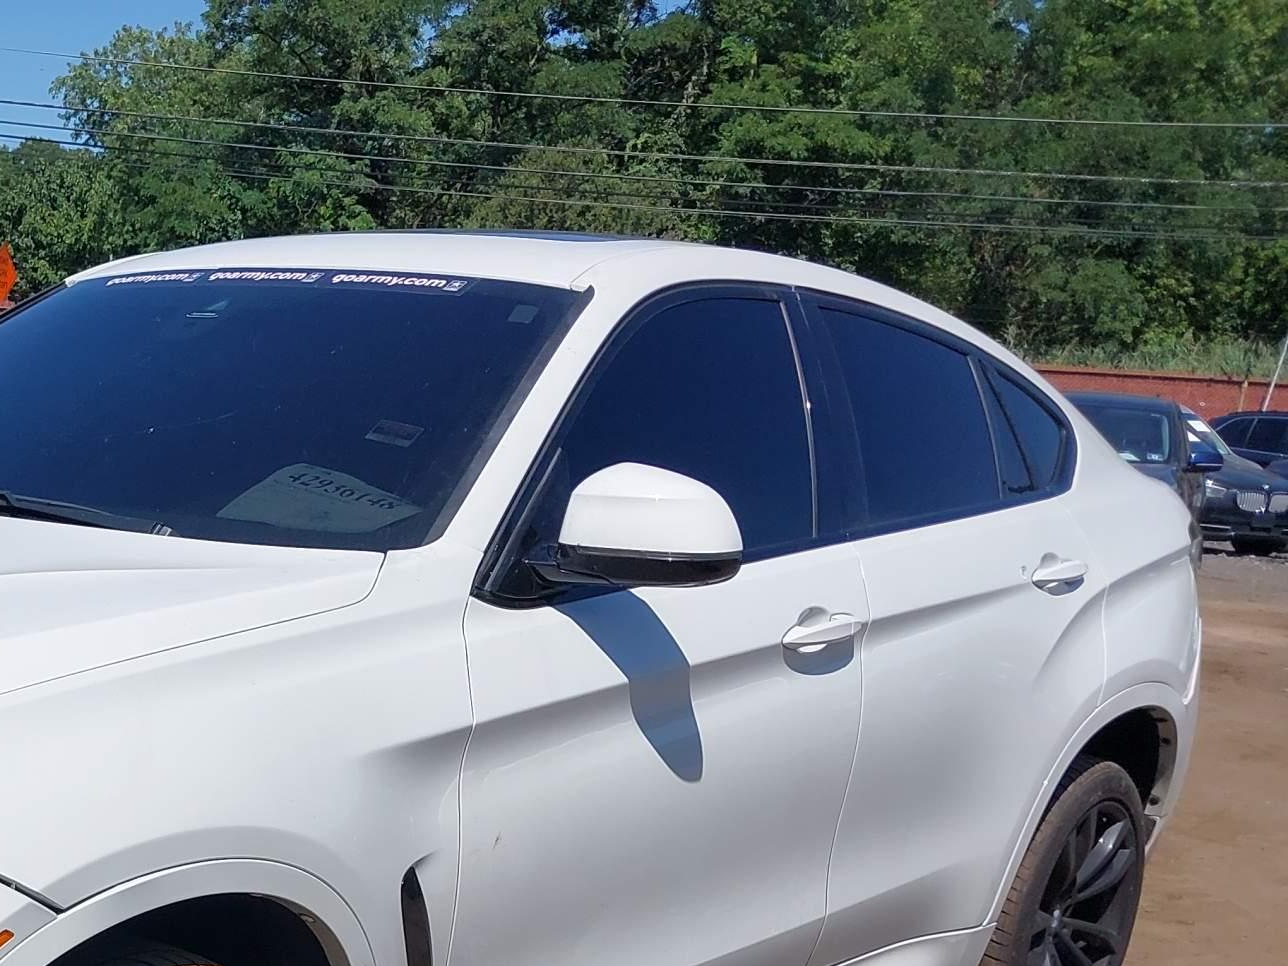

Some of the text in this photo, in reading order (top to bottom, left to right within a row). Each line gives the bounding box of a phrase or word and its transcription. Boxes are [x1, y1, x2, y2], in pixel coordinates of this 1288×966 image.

[105, 272, 190, 287] goarmy.com
[208, 271, 306, 282] goarmy.com
[331, 273, 447, 288] goarmy.com
